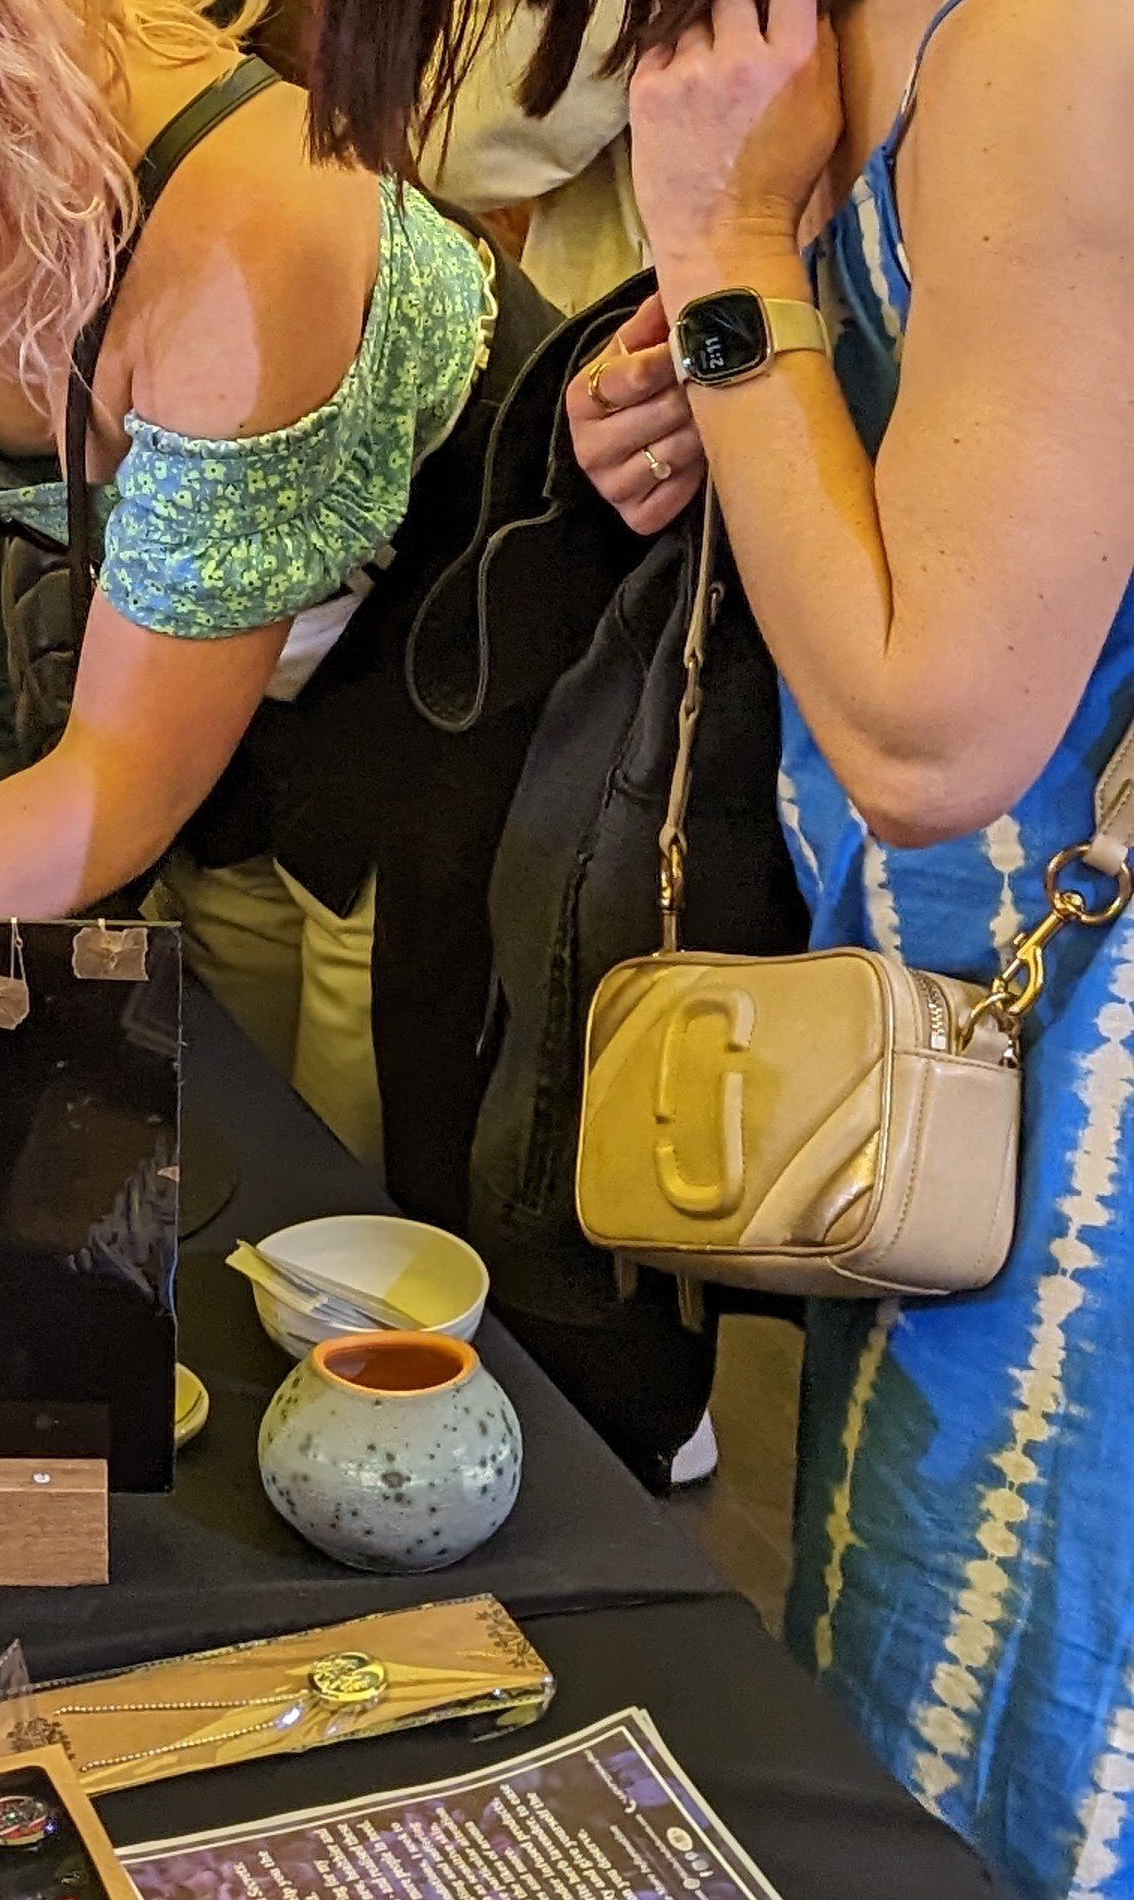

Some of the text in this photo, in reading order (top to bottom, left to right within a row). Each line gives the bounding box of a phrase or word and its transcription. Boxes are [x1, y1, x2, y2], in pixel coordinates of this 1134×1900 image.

[499, 1783, 520, 1804] ease
[526, 1791, 544, 1809] the
[312, 1826, 334, 1843] and
[337, 1822, 358, 1845] these
[435, 1806, 469, 1847] attention
[464, 1821, 490, 1849] aroma
[525, 1816, 563, 1860] lavender,
[535, 1808, 577, 1847] yourself
[397, 1832, 418, 1853] seek
[408, 1822, 456, 1878] and suffering
[577, 1827, 612, 1869] deserve.
[256, 1849, 275, 1868] the
[325, 1843, 359, 1881] healthier
[348, 1843, 381, 1877] realised
[380, 1850, 411, 1878] people
[444, 1843, 478, 1884] sensitive
[465, 1846, 506, 1892] particular
[504, 1846, 541, 1890] and more.
[519, 1840, 555, 1877] infused
[568, 1847, 594, 1868] give
[268, 1867, 291, 1887] you
[494, 1860, 515, 1883] likes
[555, 1859, 580, 1883] herb
[582, 1869, 605, 1888] and
[606, 1868, 631, 1888] you
[370, 1875, 393, 1894] and
[510, 1882, 527, 1898] the
